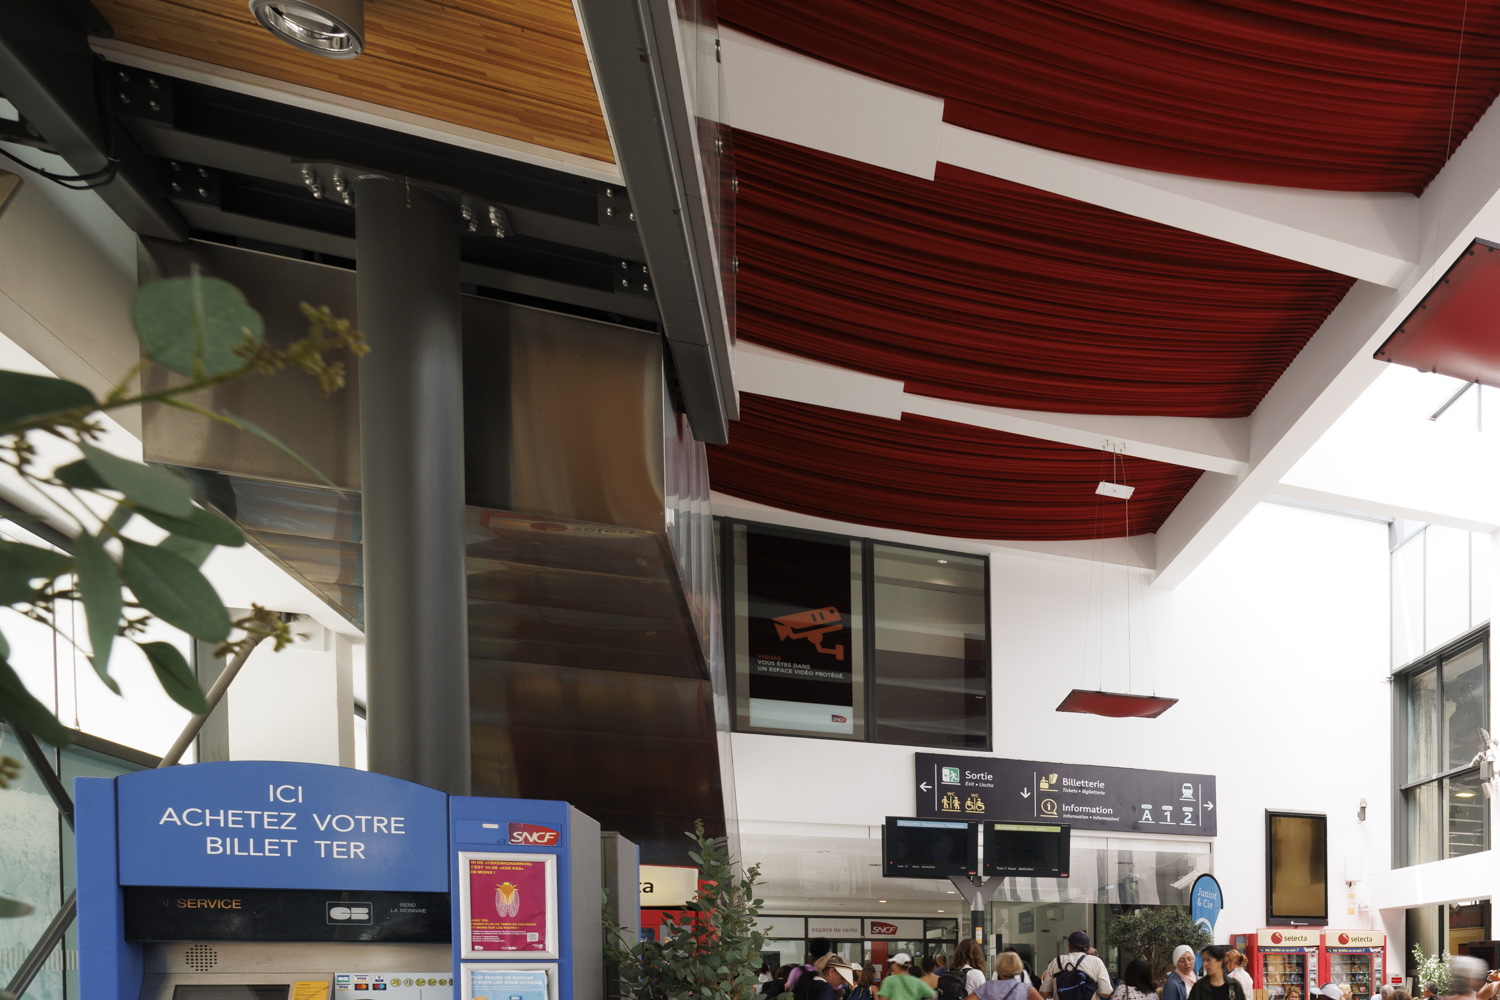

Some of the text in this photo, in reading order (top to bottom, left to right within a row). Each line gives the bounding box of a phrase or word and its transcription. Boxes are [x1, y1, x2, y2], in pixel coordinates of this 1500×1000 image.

[794, 668, 813, 676] VIDÉO
[815, 671, 844, 679] PROTÉGÉ.
[965, 771, 993, 780] Sortie
[1062, 777, 1105, 788] Billetterie
[269, 784, 302, 803] ICI
[1062, 804, 1113, 814] Information
[159, 807, 405, 834] ACHETEZ VOTRE
[1142, 810, 1192, 823] A 1 2
[511, 832, 556, 843] SNCF
[206, 836, 366, 859] BILLET TER
[1198, 888, 1217, 900] Junior
[176, 898, 242, 909] SERVICE
[1197, 898, 1213, 910] & Cie
